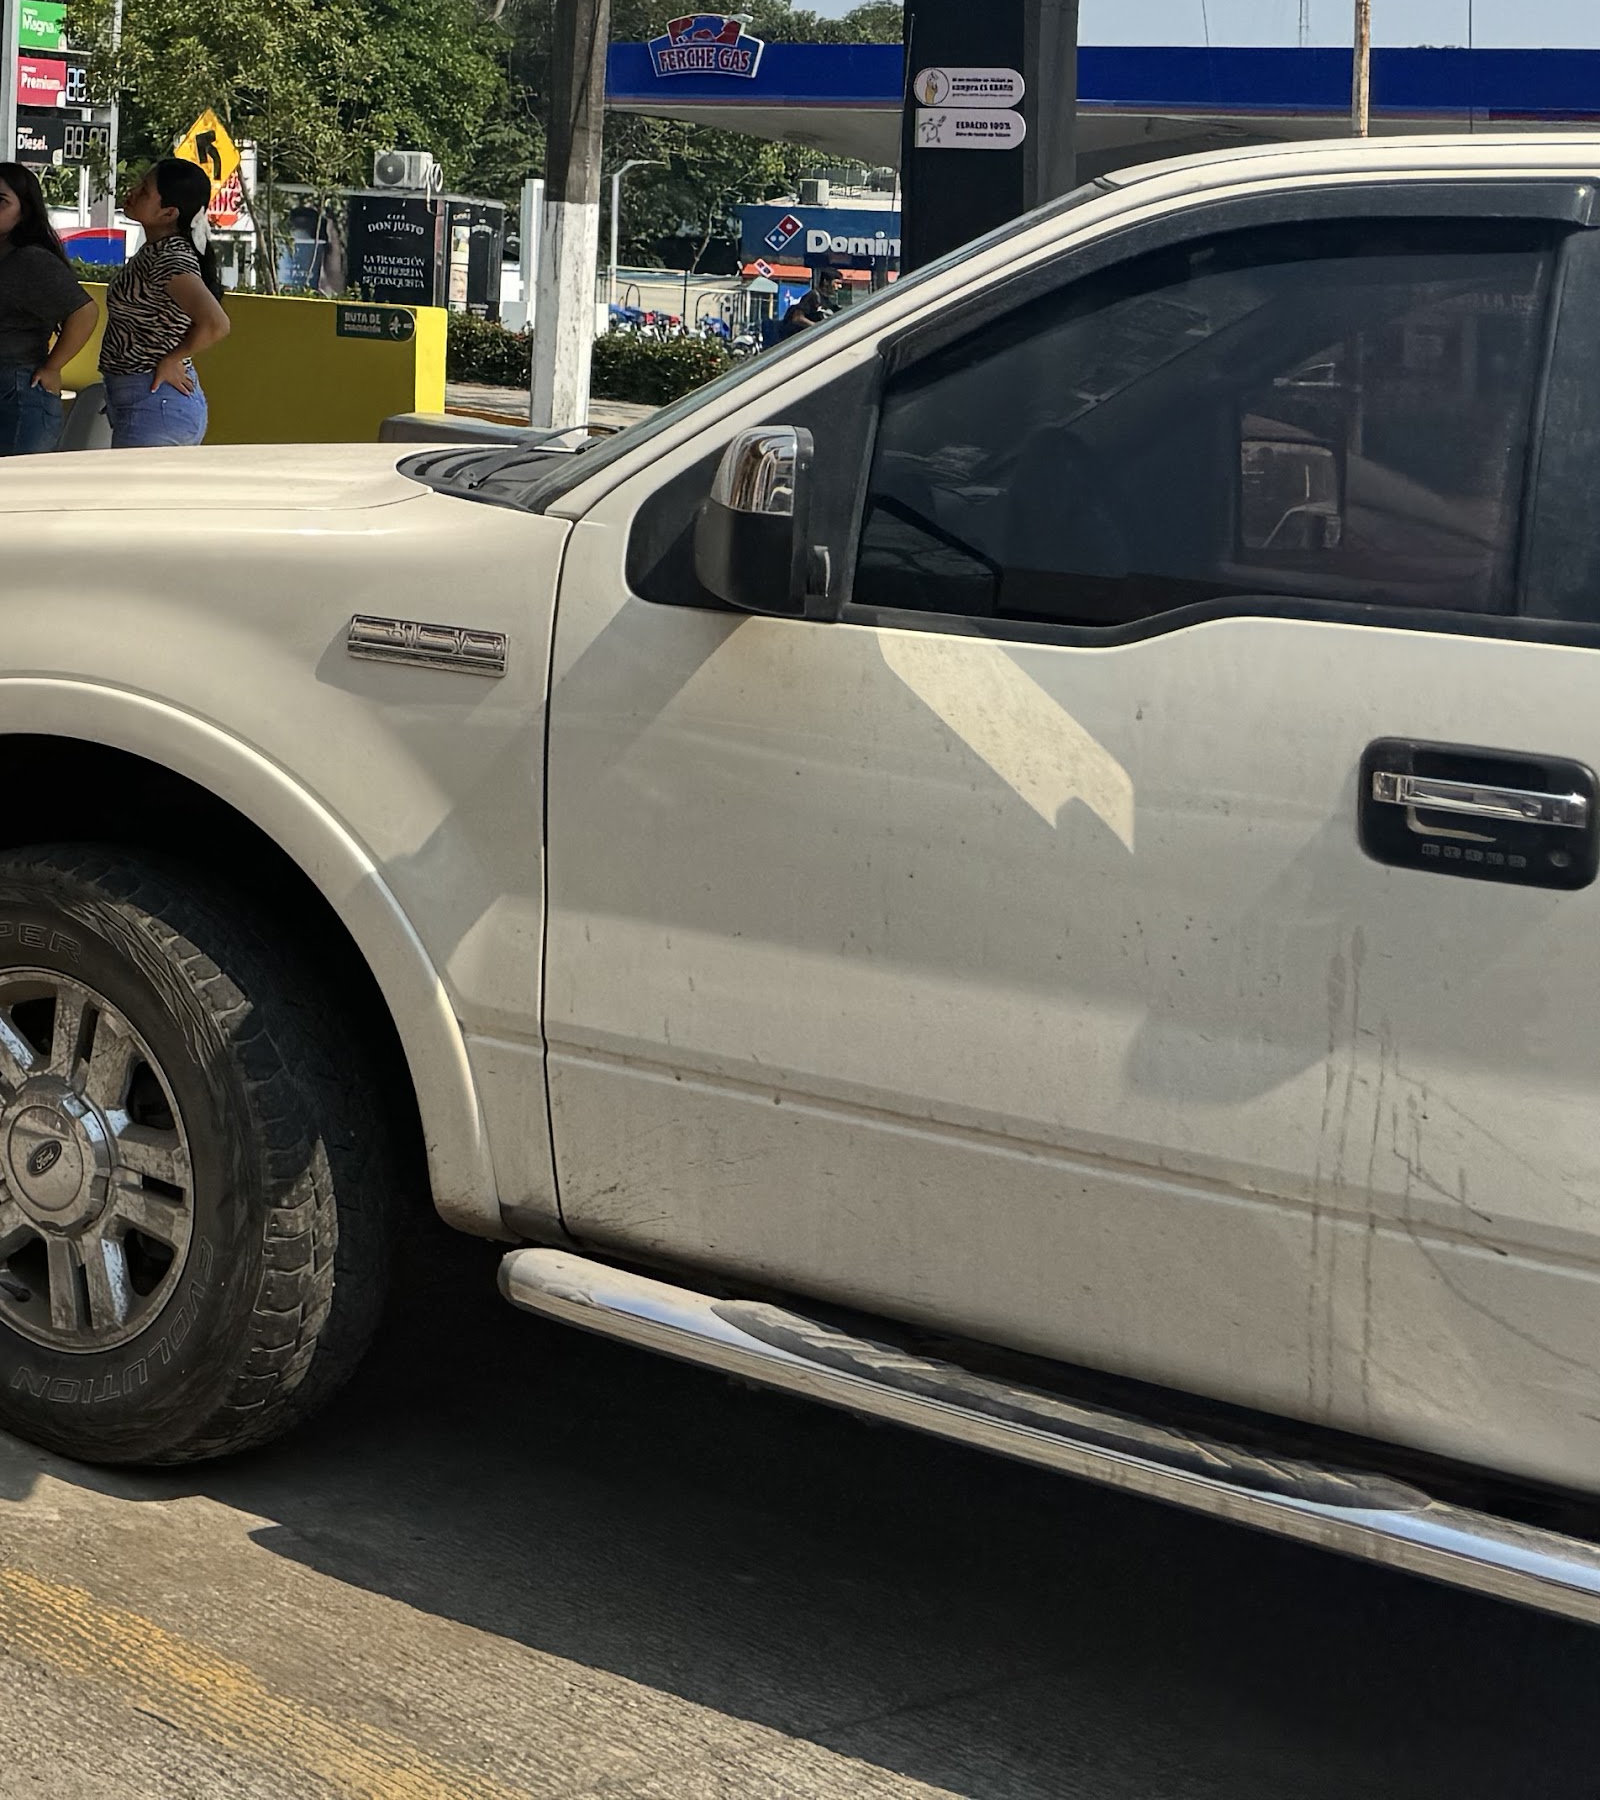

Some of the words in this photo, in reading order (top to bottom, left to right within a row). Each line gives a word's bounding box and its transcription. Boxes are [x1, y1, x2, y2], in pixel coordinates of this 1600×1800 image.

[657, 47, 716, 72] FERCHE
[718, 48, 752, 72] GAS
[367, 221, 392, 233] DON
[393, 221, 425, 236] JUSTO
[35, 1148, 54, 1170] Ford
[9, 1234, 214, 1405] EVOLUTION
